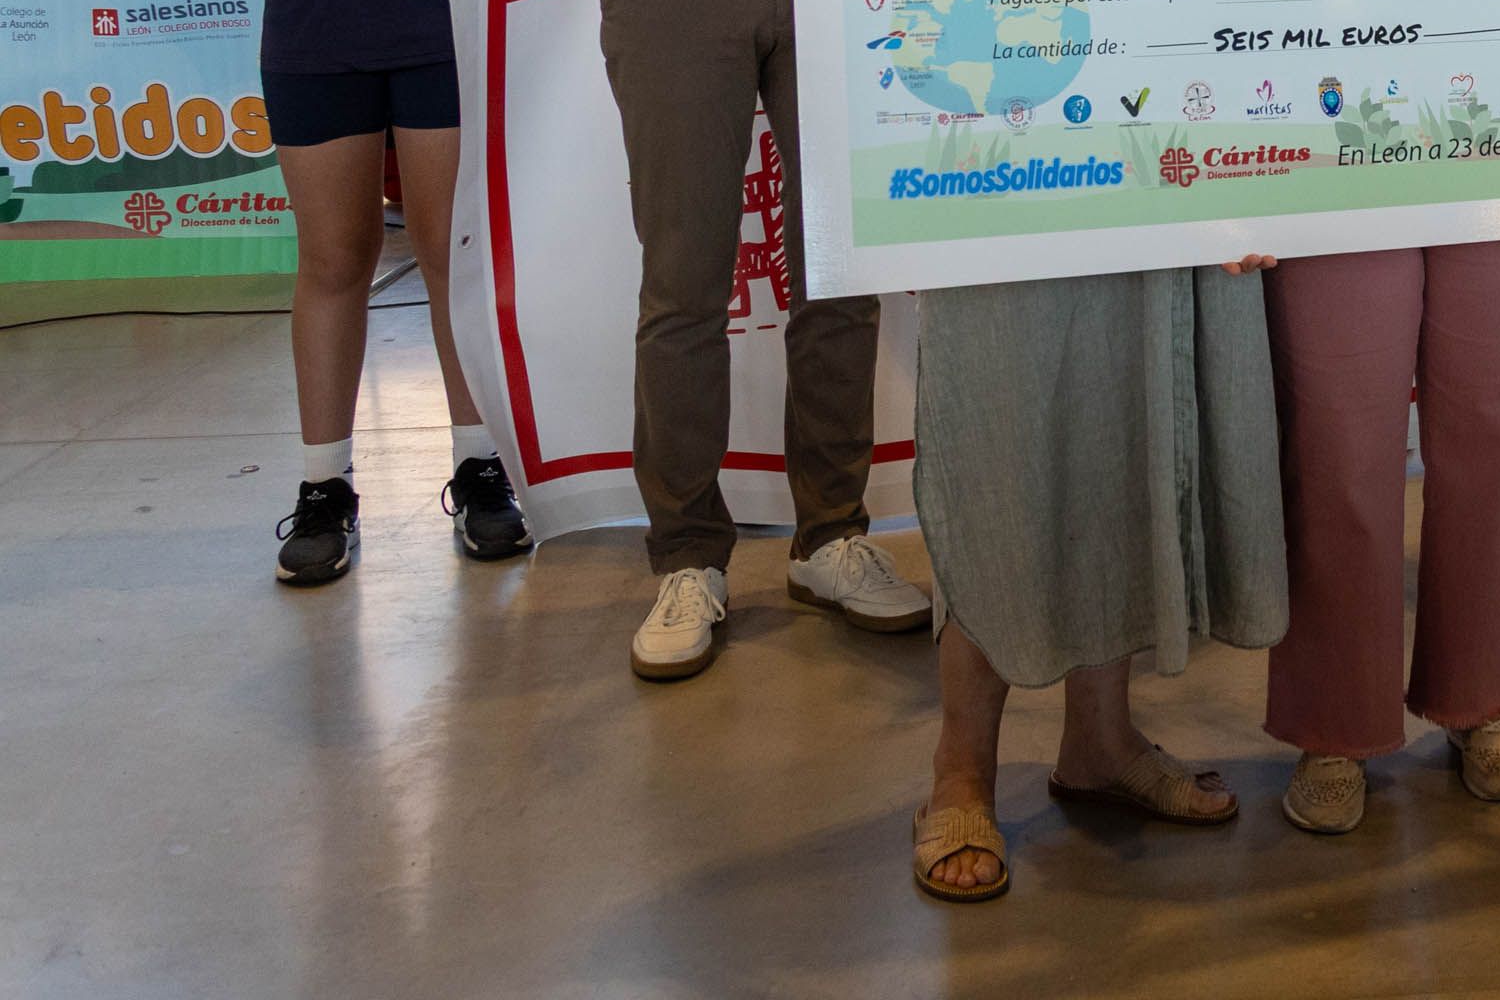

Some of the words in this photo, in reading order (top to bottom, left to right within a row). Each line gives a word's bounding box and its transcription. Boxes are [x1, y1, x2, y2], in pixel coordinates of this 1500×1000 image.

[35, 7, 47, 17] de
[126, 0, 249, 23] salesianos
[9, 18, 49, 29] Asunción
[127, 25, 152, 36] LEÓN
[158, 22, 198, 34] COLEGIO
[200, 20, 220, 30] DON
[222, 18, 251, 29] BOSCO
[12, 30, 37, 42] León
[1213, 28, 1273, 52] SEIS
[1282, 27, 1330, 48] MIL
[1341, 24, 1423, 46] EUROS
[993, 42, 1012, 59] La
[1017, 40, 1093, 58] cantidad
[1097, 38, 1118, 55] de
[1246, 102, 1293, 116] maristas
[0, 83, 273, 162] etidos
[1202, 144, 1311, 167] Cáritas
[1338, 144, 1364, 166] En
[1371, 140, 1422, 164] León
[1428, 144, 1442, 160] a
[1448, 138, 1473, 159] 23
[889, 156, 1123, 200] #SomosSolidarios
[1207, 169, 1253, 180] Diocesana
[1255, 167, 1266, 177] de
[1268, 166, 1290, 176] León
[176, 192, 295, 213] Cárita
[181, 216, 236, 228] Diocesana
[239, 216, 251, 226] de
[254, 214, 280, 226] León
